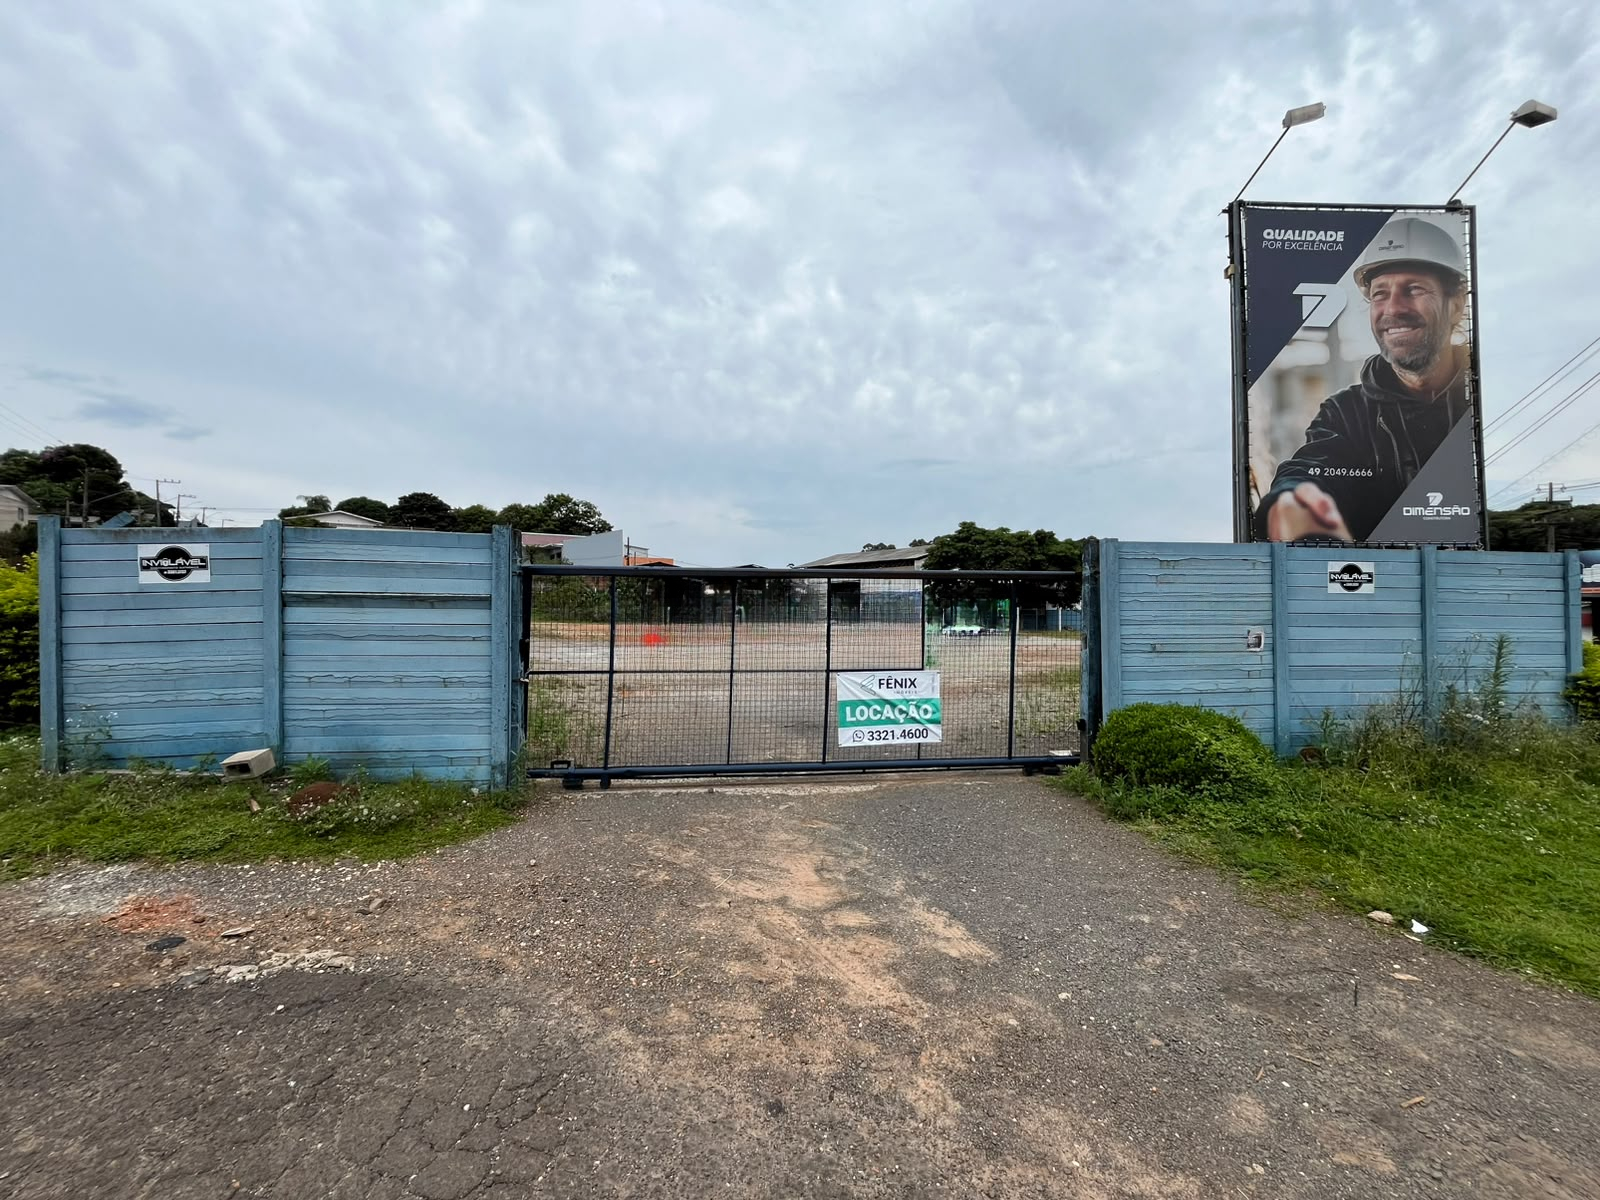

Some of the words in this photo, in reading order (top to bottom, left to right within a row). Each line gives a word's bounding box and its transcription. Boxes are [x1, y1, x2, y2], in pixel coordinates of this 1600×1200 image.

[1262, 228, 1345, 242] QUALIDADE
[1262, 240, 1282, 249] POR
[1284, 240, 1343, 251] EXCELÊNCIA
[1308, 467, 1321, 476] 49
[1323, 467, 1373, 477] 2049.6666
[1402, 505, 1471, 516] DIMENSÃO
[878, 675, 917, 690] FÊNIX
[845, 701, 934, 723] LOCAÇÃO
[867, 728, 929, 742] 3321.4600
